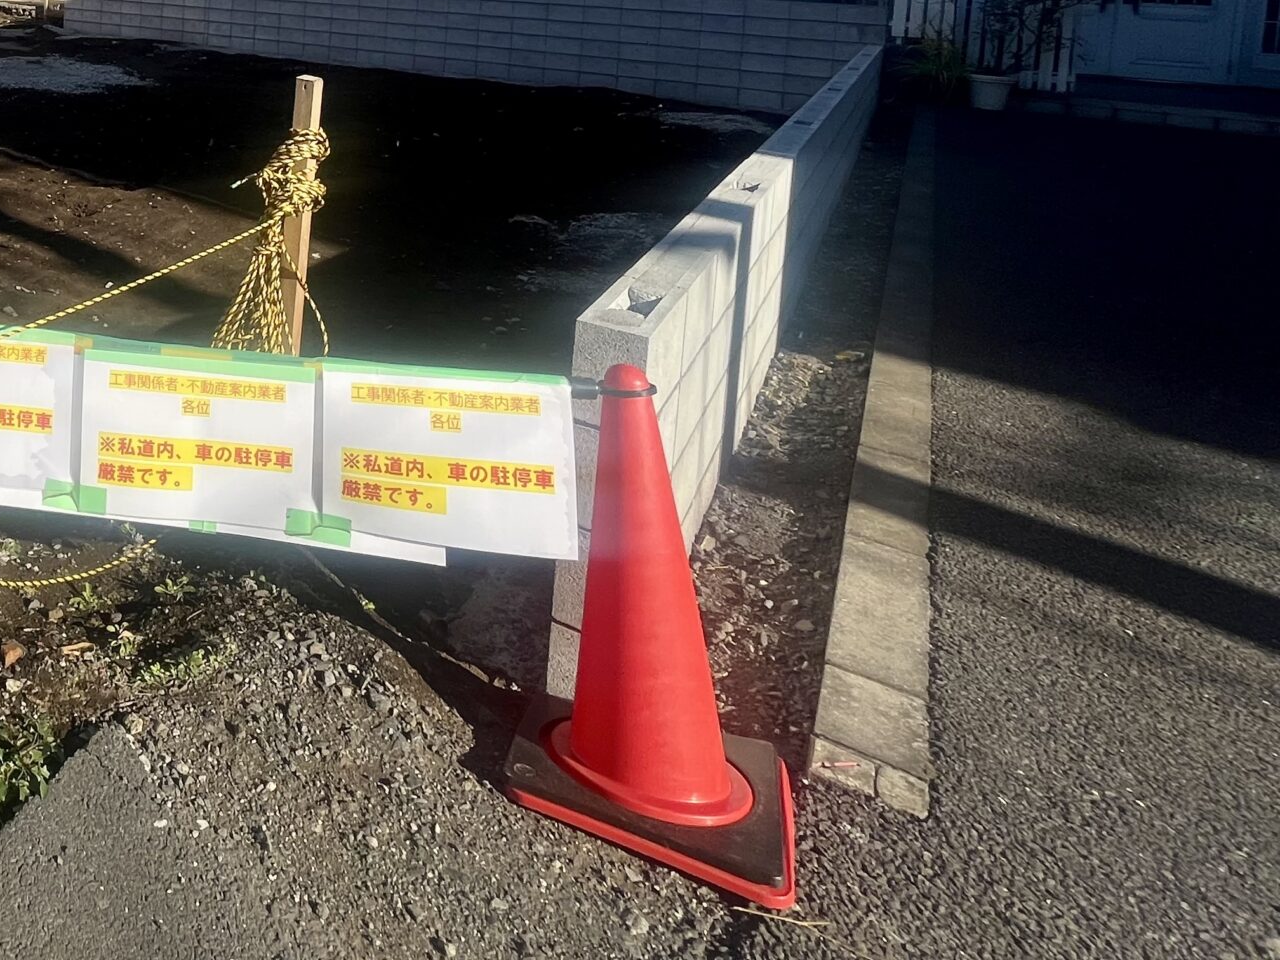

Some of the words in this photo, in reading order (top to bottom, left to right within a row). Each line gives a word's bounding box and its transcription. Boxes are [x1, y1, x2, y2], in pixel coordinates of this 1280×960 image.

[182, 400, 211, 416] 各位
[431, 413, 461, 430] 各位
[99, 436, 293, 469] ※私道内、車の駐停車
[98, 462, 182, 487] 厳禁です。
[343, 452, 555, 489] ※私道内、車の駐停車
[342, 479, 433, 510] 厳禁です。
